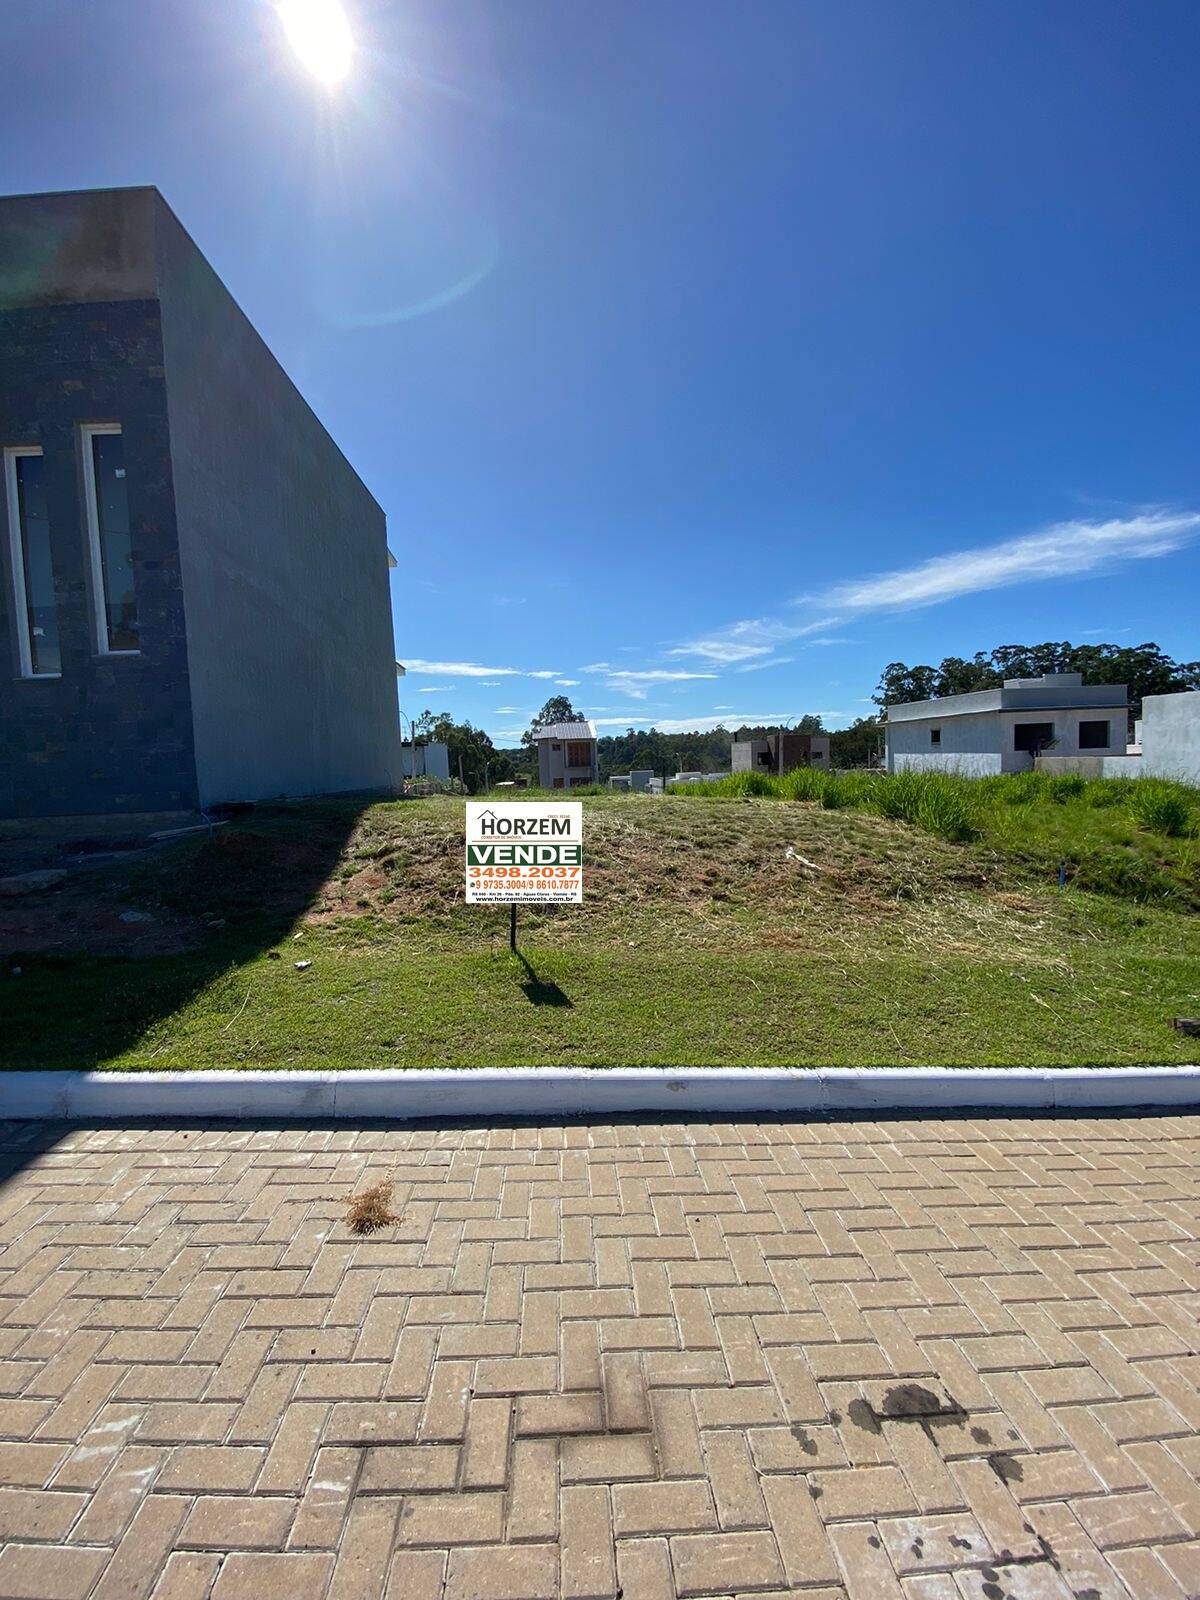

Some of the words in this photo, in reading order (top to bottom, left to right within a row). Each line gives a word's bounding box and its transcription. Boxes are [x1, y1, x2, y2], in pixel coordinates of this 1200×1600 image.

[481, 818, 571, 835] HORZEM
[471, 846, 578, 864] VENDE
[469, 867, 580, 878] 3498.2037
[476, 880, 481, 889] 9
[536, 880, 579, 889] 8610.7877
